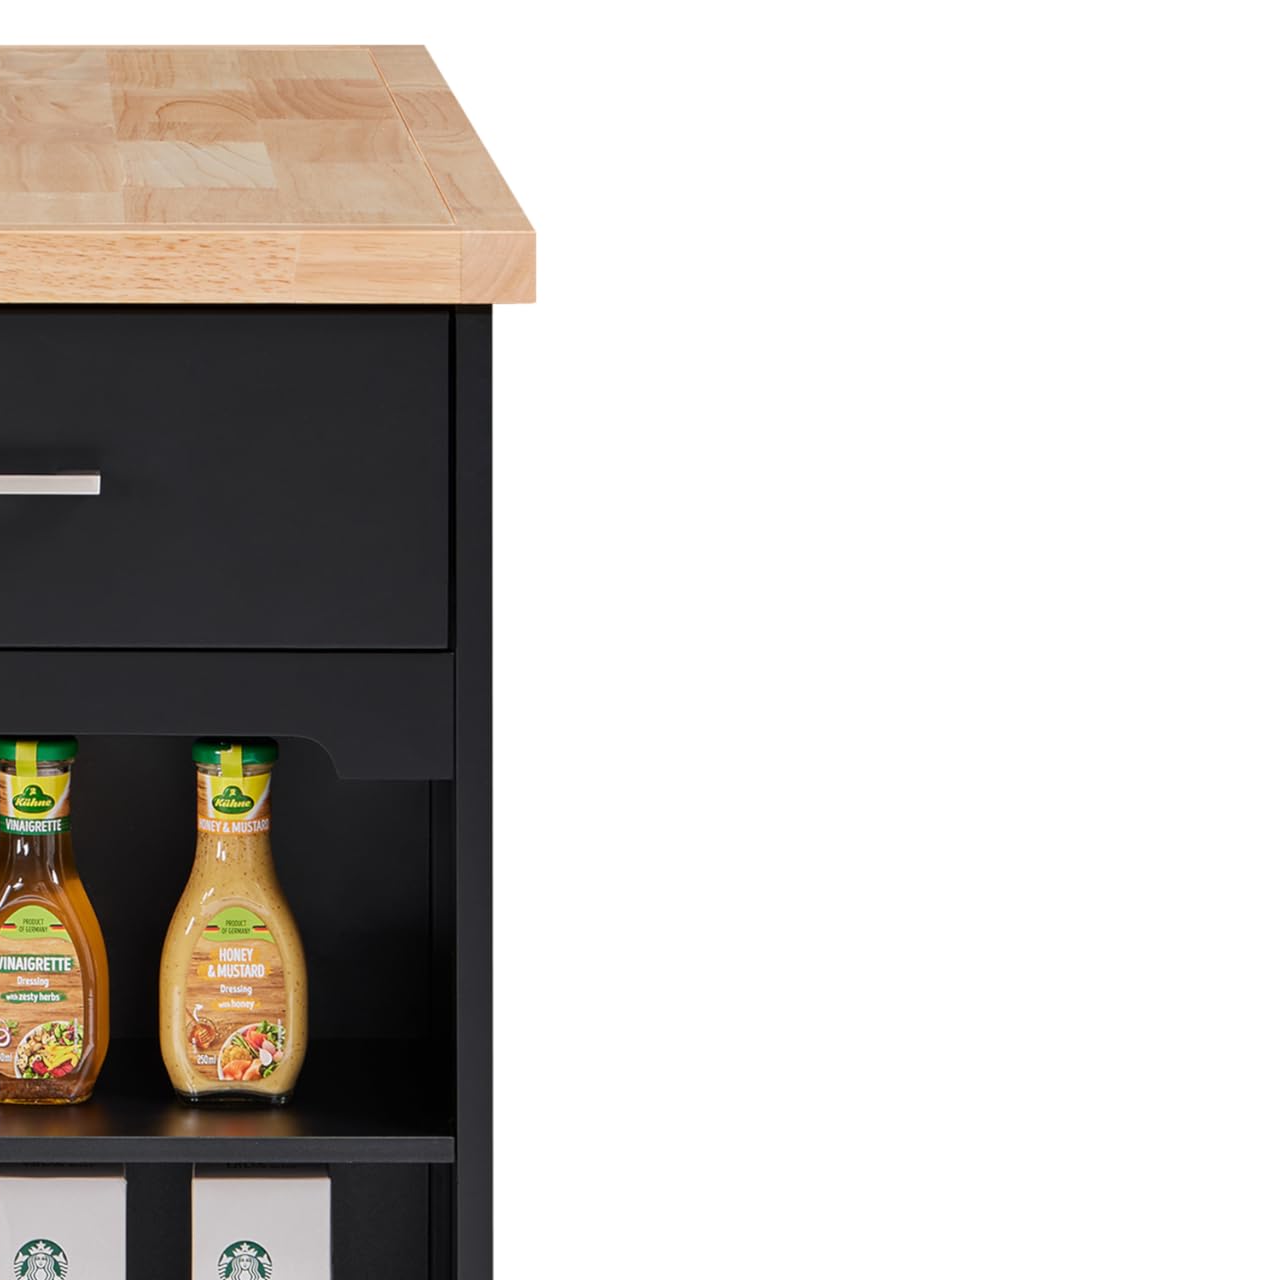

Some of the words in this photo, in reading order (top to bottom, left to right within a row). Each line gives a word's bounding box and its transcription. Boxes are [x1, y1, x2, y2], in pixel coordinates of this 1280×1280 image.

[15, 797, 52, 807] Kühne
[214, 798, 252, 808] Kühne
[5, 818, 62, 833] VINAIGRETTE
[222, 821, 230, 833] &
[219, 948, 253, 962] HONEY
[207, 964, 216, 978] &
[217, 964, 265, 978] MUSTARD
[17, 976, 49, 987] Dressing
[220, 984, 252, 995] Dressing
[19, 993, 39, 1003] zesty
[39, 992, 60, 1001] herbs
[231, 1000, 255, 1010] honey
